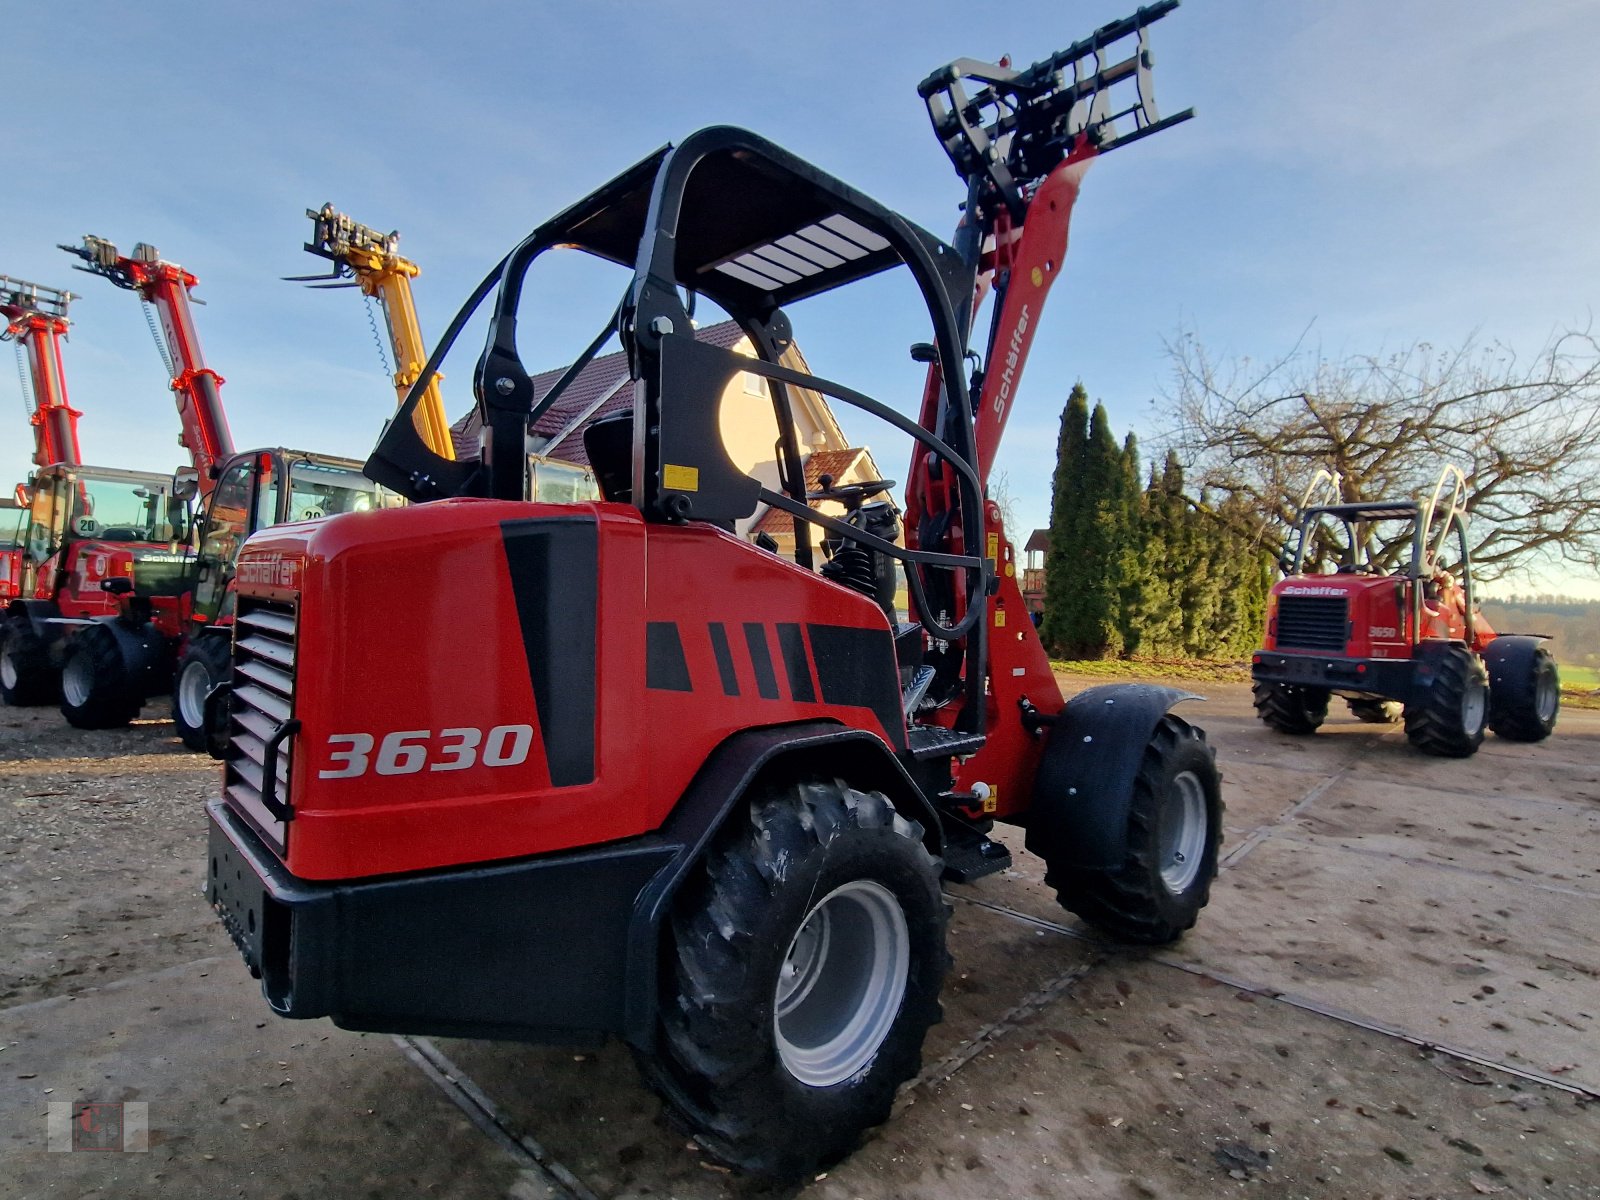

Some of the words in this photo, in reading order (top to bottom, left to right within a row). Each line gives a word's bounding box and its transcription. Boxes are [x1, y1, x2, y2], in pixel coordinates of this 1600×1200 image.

[994, 304, 1029, 423] Schäffer
[80, 520, 95, 532] 20
[1281, 586, 1348, 596] Schäffer
[1368, 626, 1396, 638] 3650
[318, 724, 534, 779] 3630
